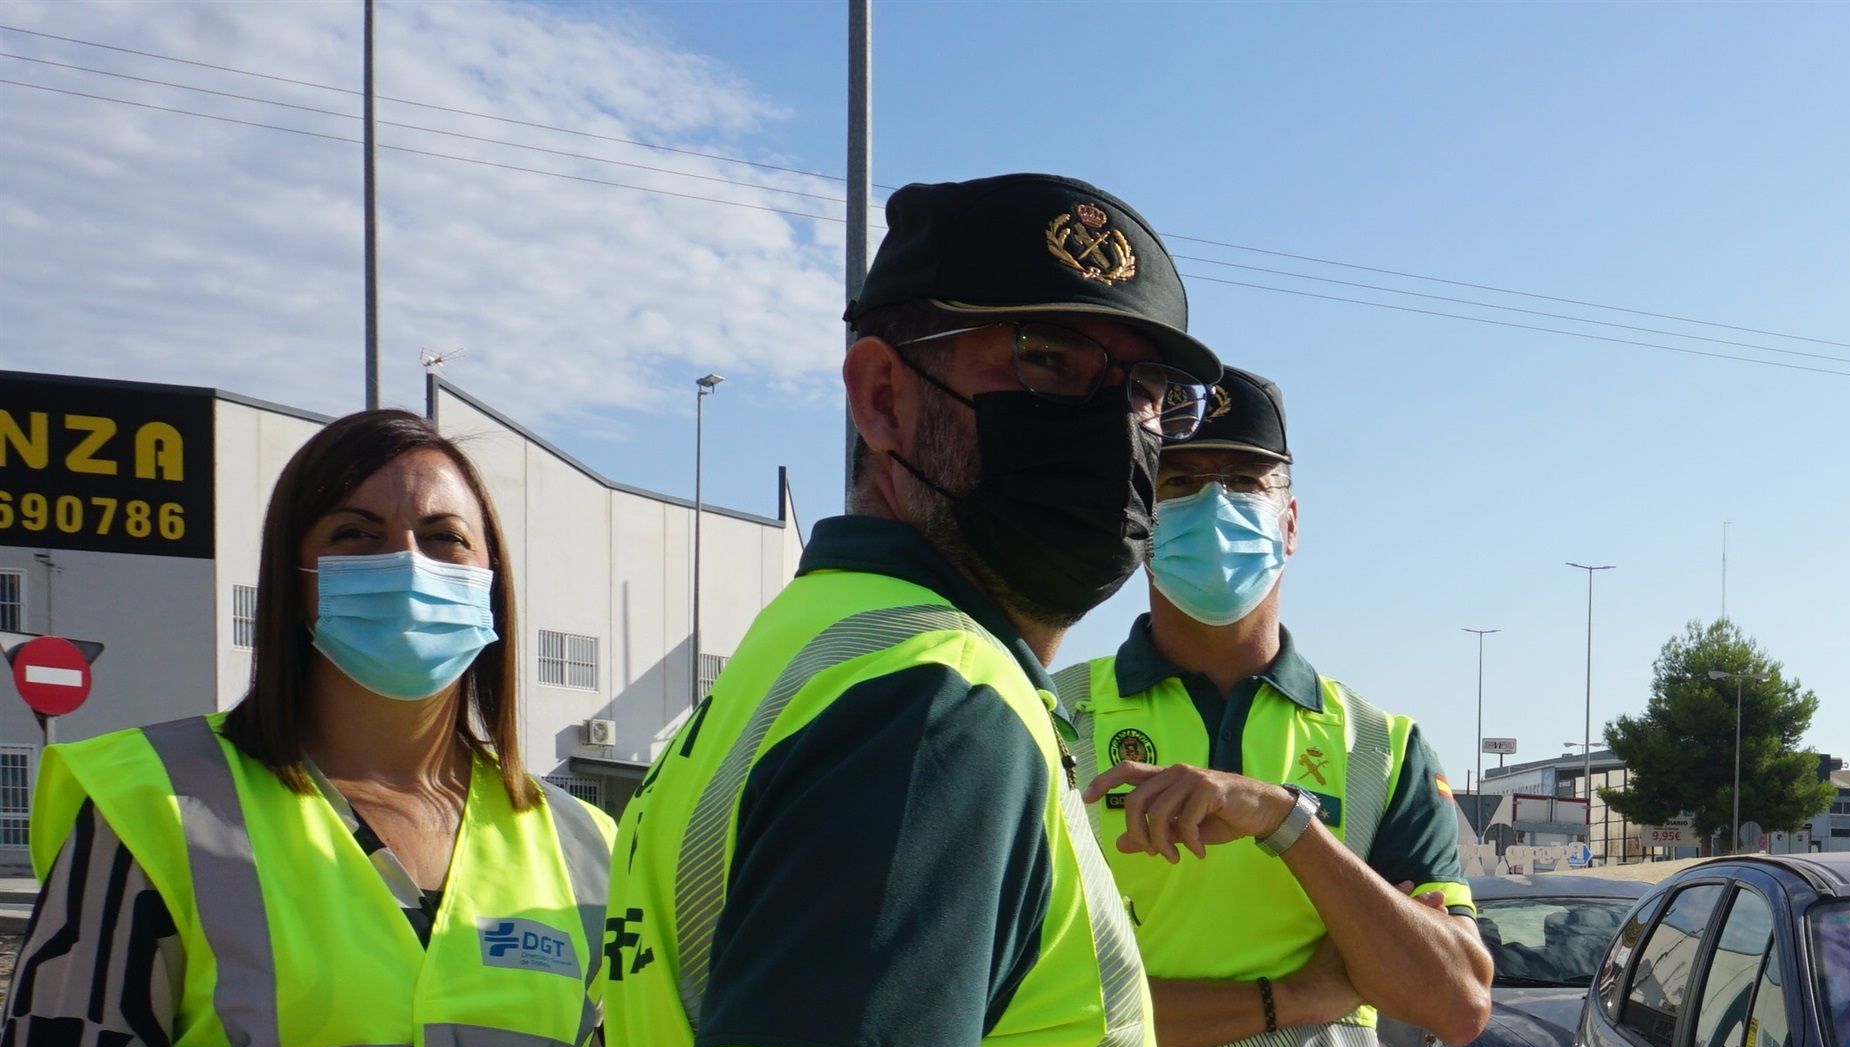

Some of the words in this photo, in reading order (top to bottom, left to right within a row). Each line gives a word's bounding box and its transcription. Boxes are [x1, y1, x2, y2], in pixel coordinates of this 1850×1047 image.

[0, 409, 184, 481] NZA
[1652, 831, 1682, 842] 9,95€
[522, 931, 565, 957] DGT
